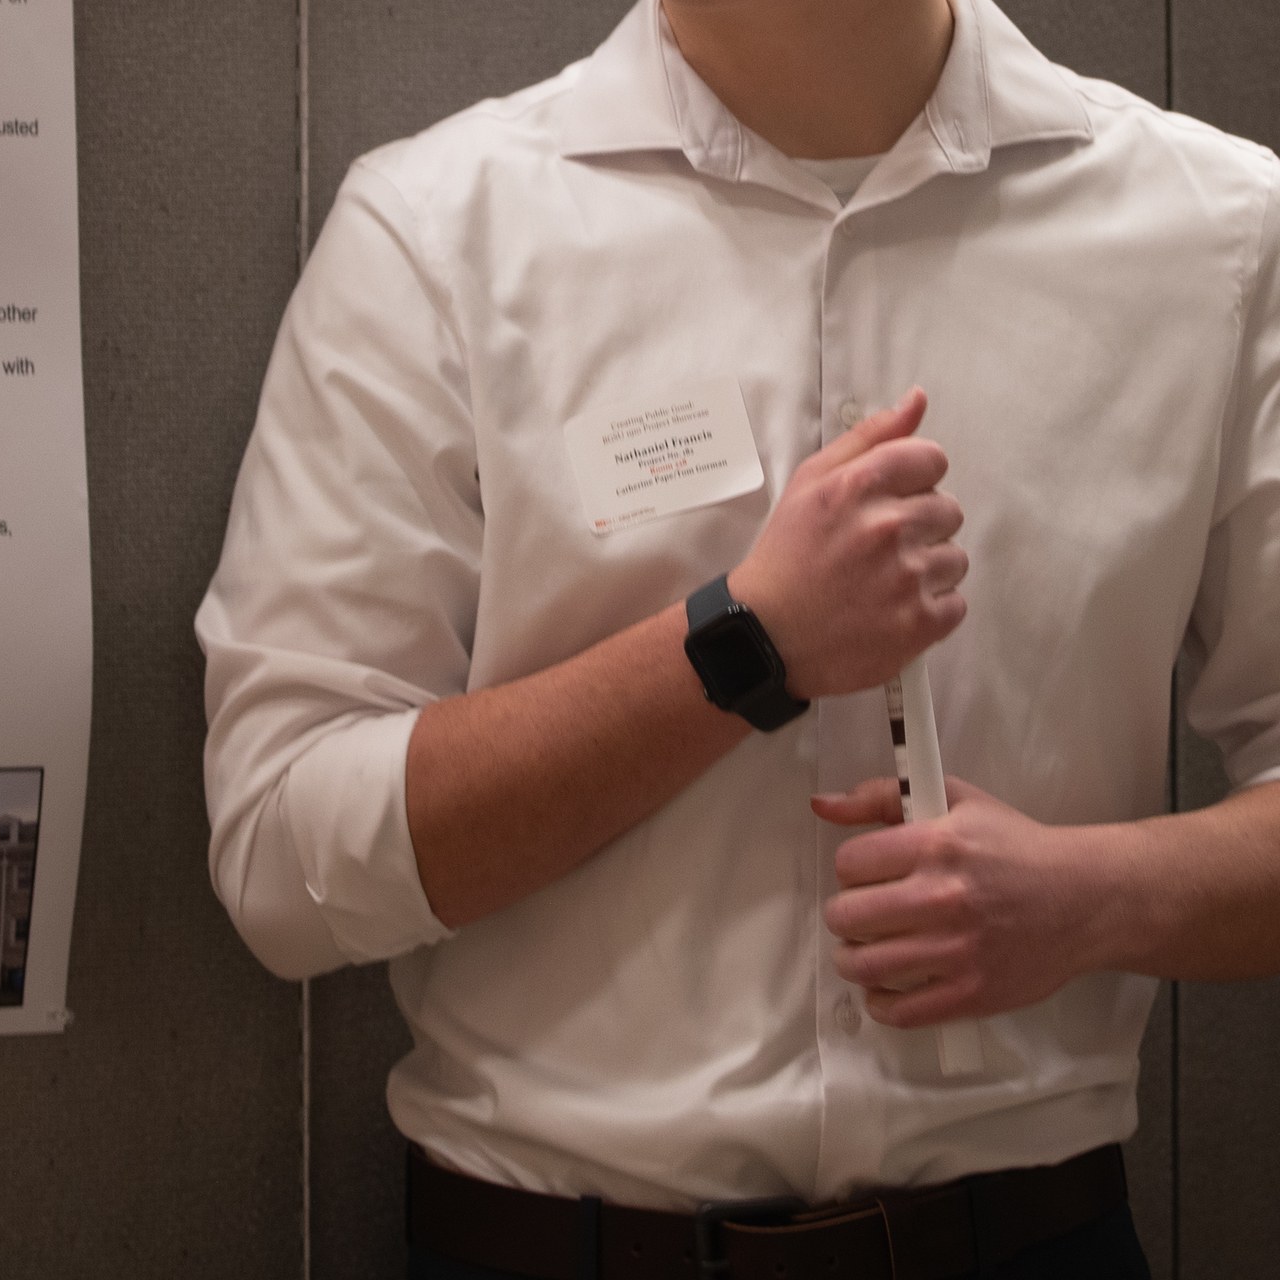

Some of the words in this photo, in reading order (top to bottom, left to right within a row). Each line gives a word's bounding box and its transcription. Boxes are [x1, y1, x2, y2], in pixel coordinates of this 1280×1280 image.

[643, 419, 670, 434] Project
[614, 439, 669, 465] Nathaniel
[671, 429, 713, 448] Francis
[637, 454, 666, 469] Project
